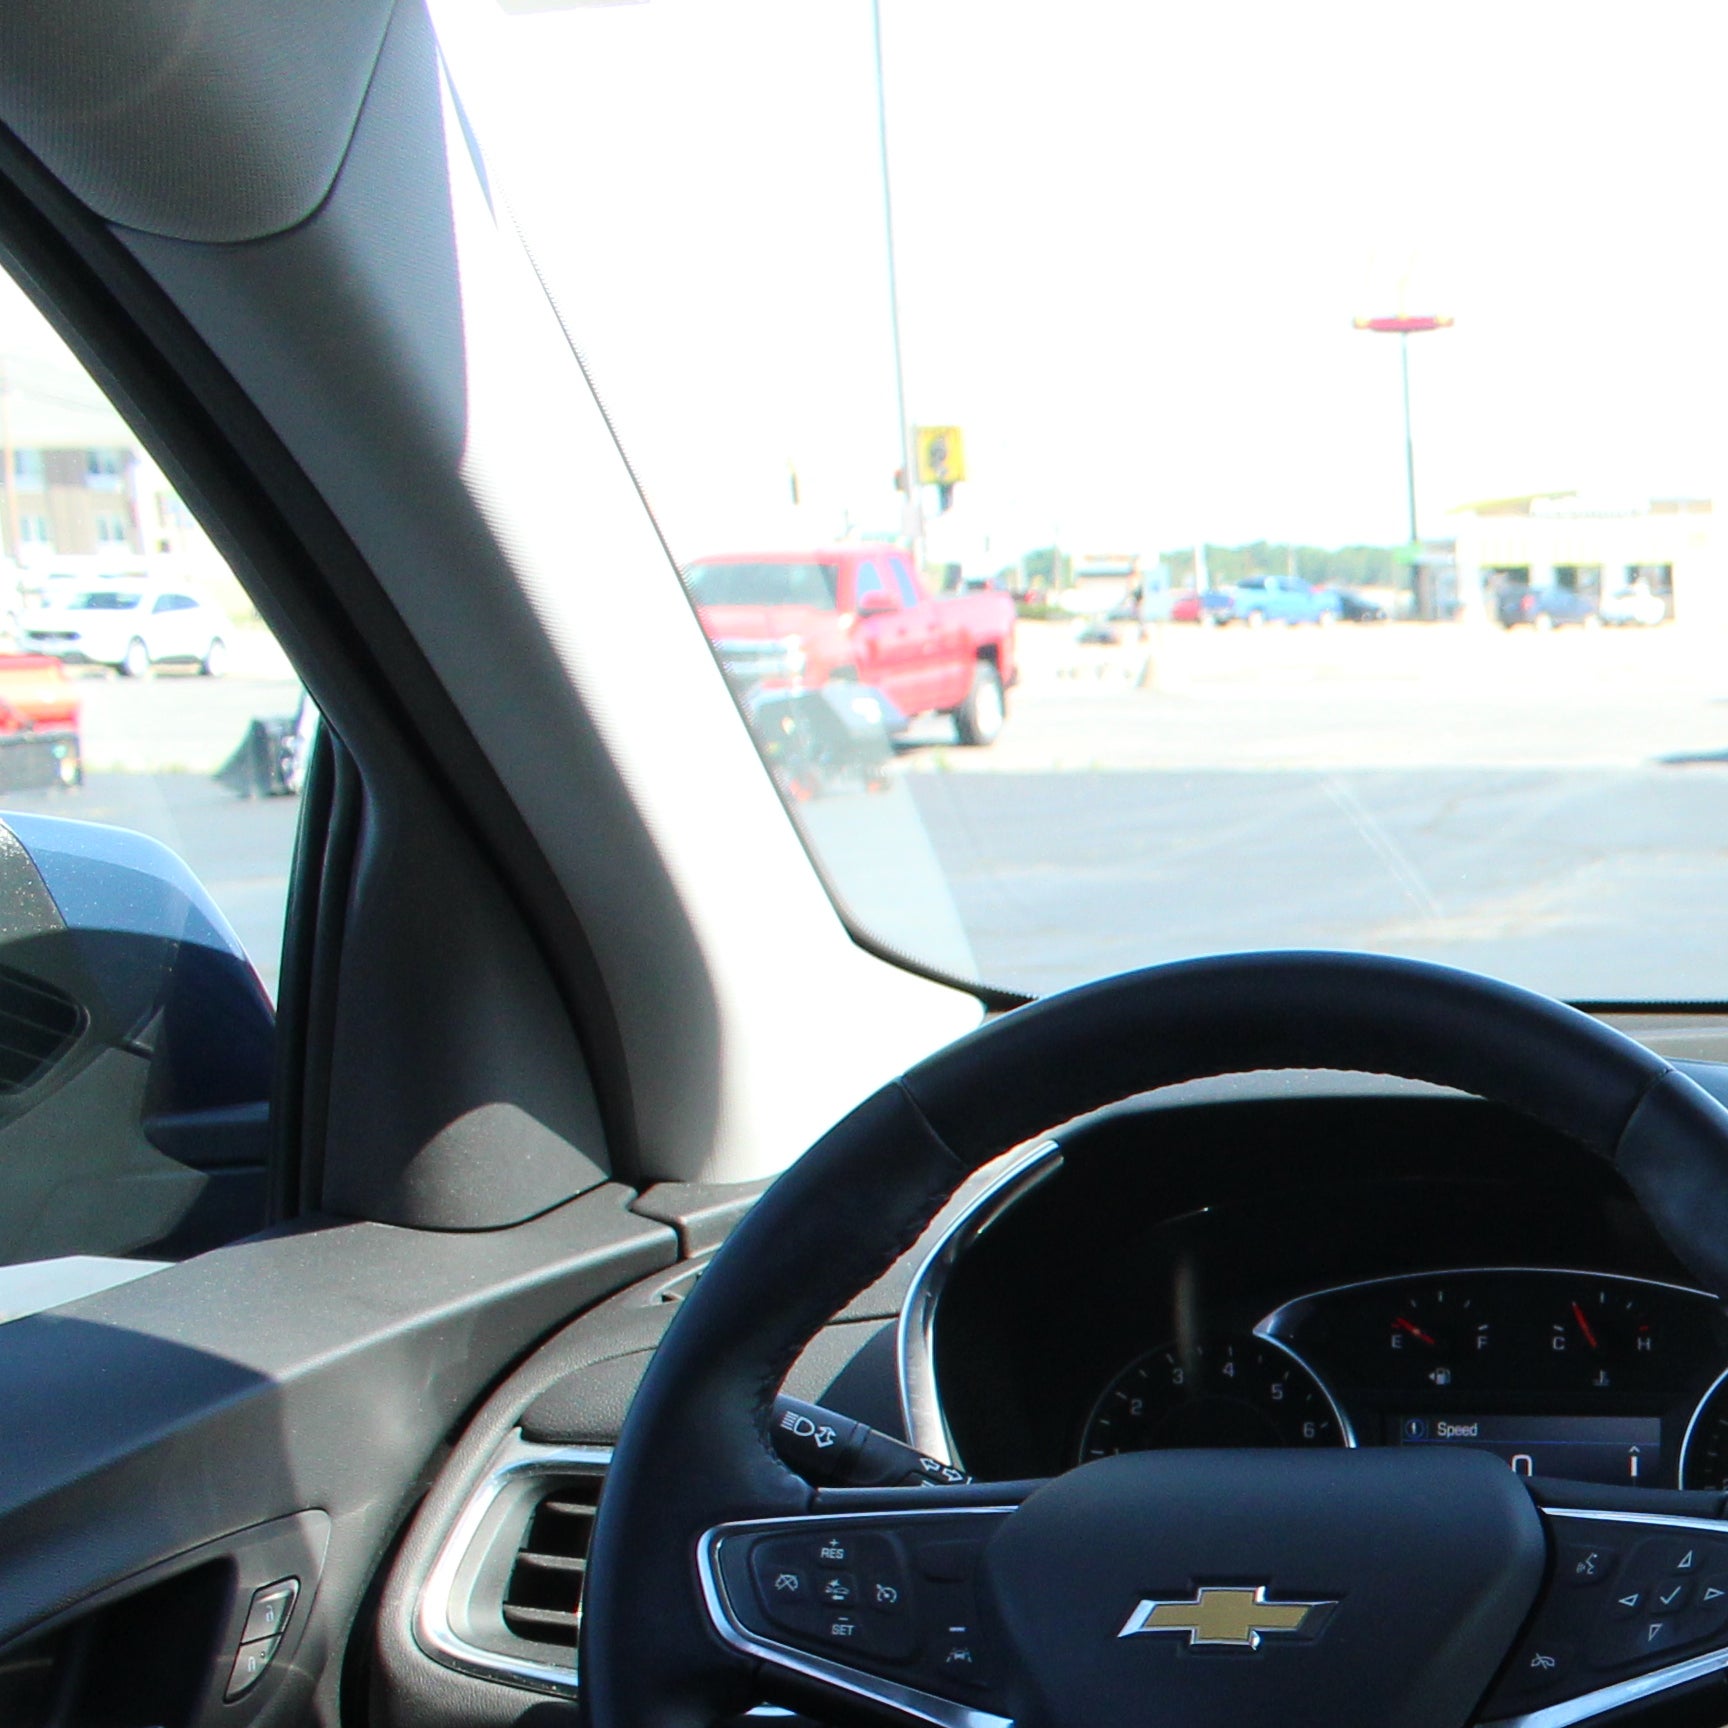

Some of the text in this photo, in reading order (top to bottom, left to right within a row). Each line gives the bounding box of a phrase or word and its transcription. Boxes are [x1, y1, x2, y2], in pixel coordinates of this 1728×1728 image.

[1391, 1334, 1402, 1349] E
[1477, 1336, 1488, 1350] F
[1552, 1336, 1566, 1351] C
[1637, 1337, 1651, 1351] H
[1172, 1368, 1184, 1385] 3
[1222, 1362, 1235, 1378] 4
[1271, 1383, 1283, 1401] 5
[1130, 1399, 1143, 1416] 2
[1303, 1422, 1315, 1439] 6
[1437, 1421, 1479, 1438] Speed
[820, 1547, 845, 1560] RES
[831, 1623, 855, 1636] SET
